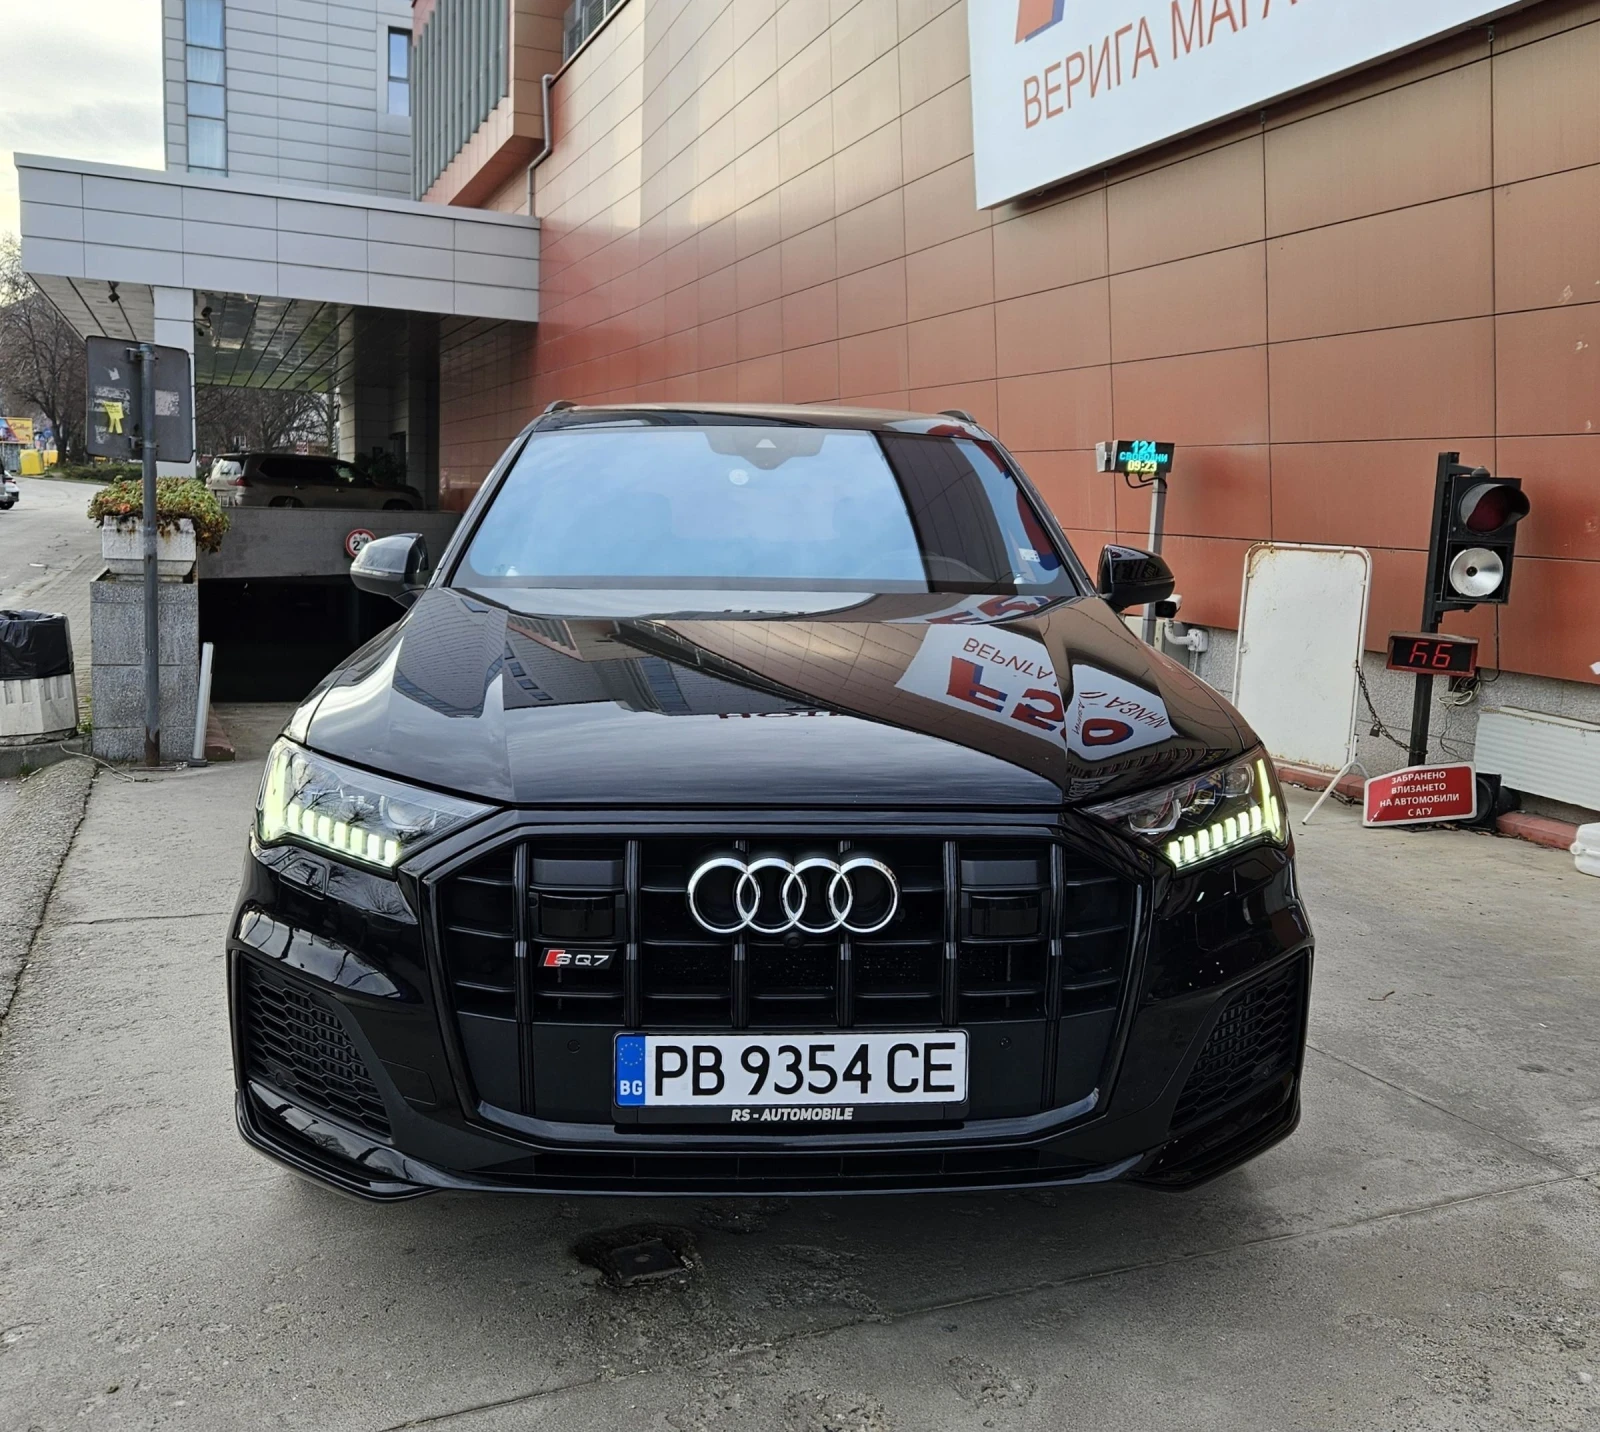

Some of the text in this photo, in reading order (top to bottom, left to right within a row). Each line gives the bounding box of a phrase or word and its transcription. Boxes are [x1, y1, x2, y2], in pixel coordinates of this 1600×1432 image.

[1023, 16, 1159, 129] ВЕРИГА
[1171, 0, 1298, 60] МА
[1132, 440, 1156, 454] 124
[1119, 451, 1168, 463] СВОБОДНИ
[1127, 460, 1157, 472] 09:23
[1391, 771, 1446, 784] ЗАБРАНЕНО
[1391, 783, 1447, 795] ВЛИЗАНЕТО
[1380, 793, 1460, 807] НА АВТОМОБИЛИ
[1416, 807, 1433, 816] АГУ
[655, 1042, 955, 1096] PB 9354 CE
[620, 1080, 643, 1096] BG
